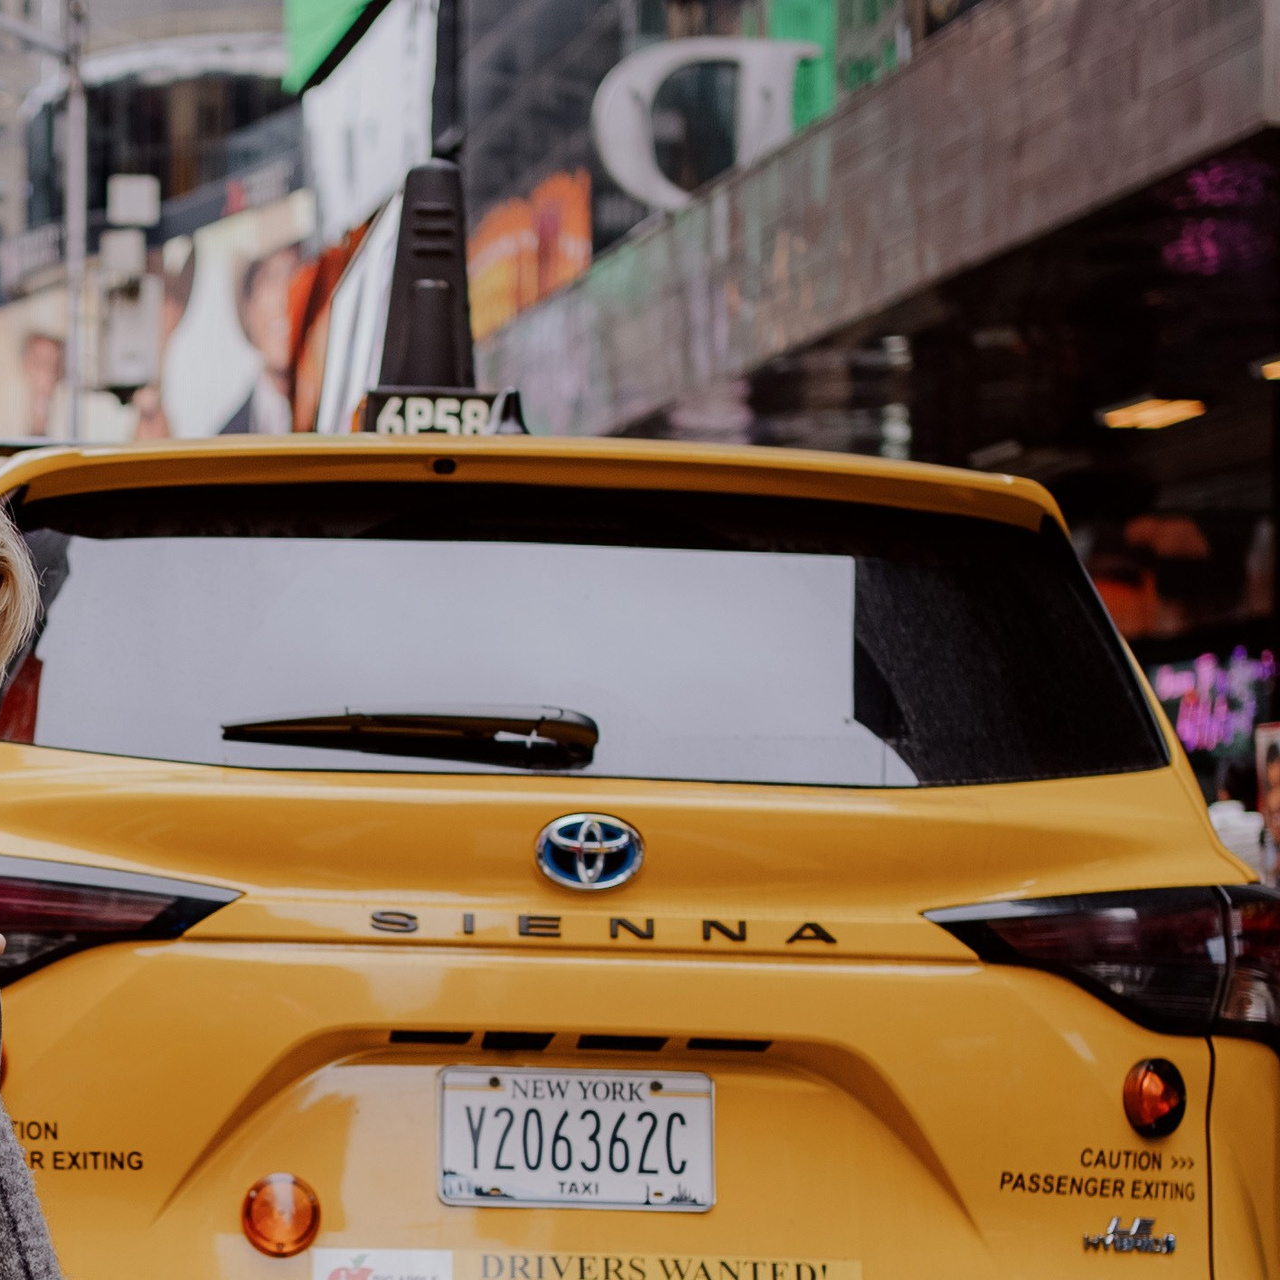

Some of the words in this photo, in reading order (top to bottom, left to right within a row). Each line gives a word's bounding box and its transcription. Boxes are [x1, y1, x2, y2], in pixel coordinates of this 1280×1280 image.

[370, 910, 839, 945] SIENNA
[511, 1079, 569, 1100] NEW
[577, 1081, 644, 1102] YORK
[465, 1105, 688, 1175] Y206362C
[52, 1150, 144, 1171] EXITING
[1080, 1147, 1163, 1171] CAUTION
[558, 1181, 600, 1196] TAXI
[999, 1171, 1126, 1199] PASSENGER
[1131, 1178, 1196, 1202] EXITING
